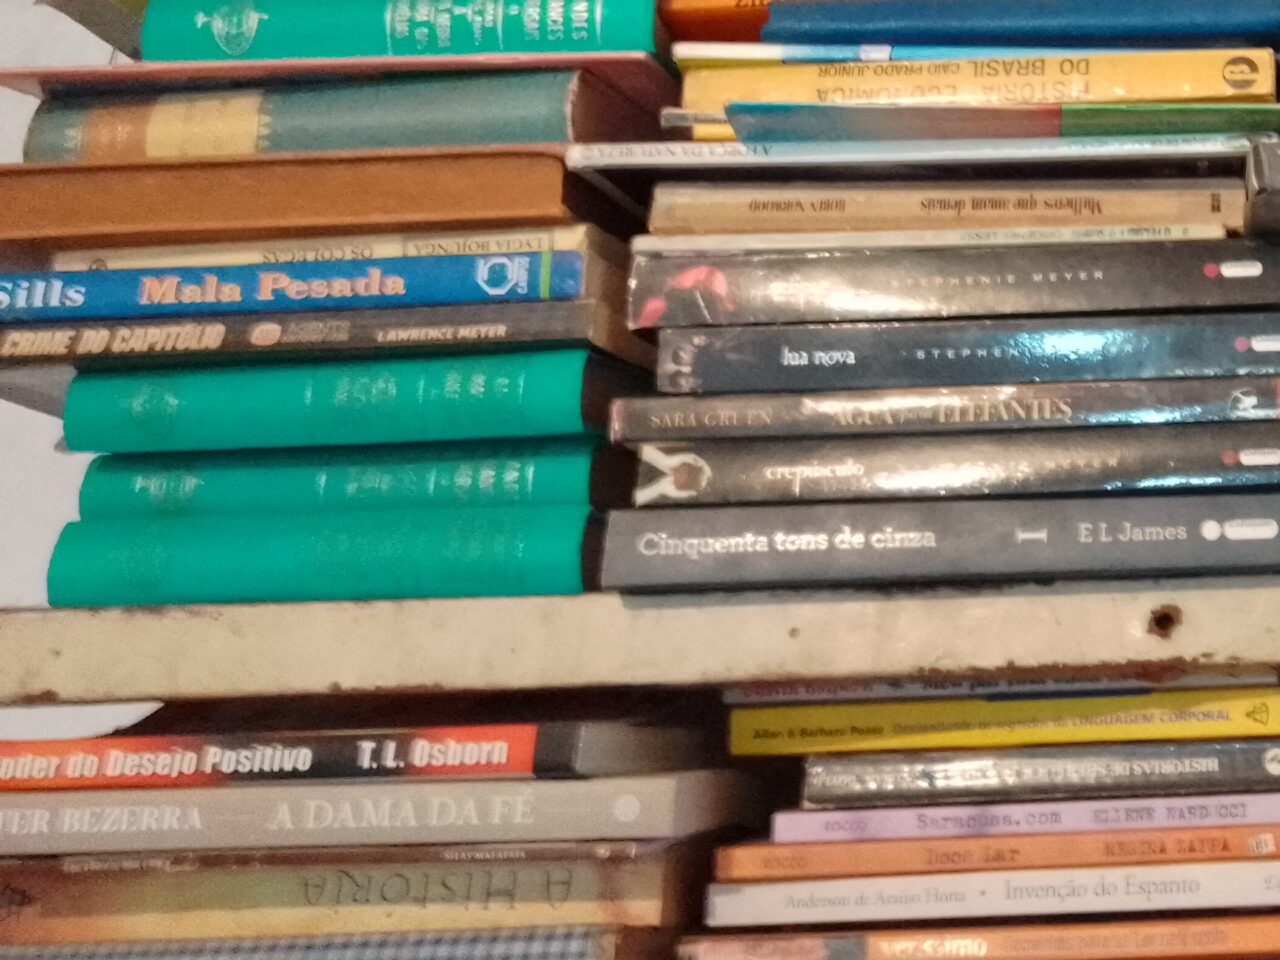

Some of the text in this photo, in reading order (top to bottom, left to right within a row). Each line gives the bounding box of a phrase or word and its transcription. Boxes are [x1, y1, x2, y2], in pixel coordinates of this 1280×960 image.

[872, 63, 923, 76] PRADO
[928, 63, 960, 76] CAIO
[1059, 58, 1090, 76] DO
[919, 197, 1103, 215] Mulheres que amam demais
[139, 273, 242, 306] Mala
[256, 267, 407, 302] Pesada
[1032, 270, 1105, 283] MEYER
[376, 323, 508, 343] LAWRENCE MEYER
[781, 345, 857, 367] lua nova
[637, 521, 1189, 560] Cinquenta tons de cinza E L James
[66, 751, 100, 779] do
[105, 747, 198, 778] Desejo
[202, 742, 313, 774] Positivo
[409, 737, 509, 768] Osborn
[59, 788, 535, 833] BEZERRA A DAMA DA FÉ
[1005, 872, 1201, 903] Invenção do Espanto
